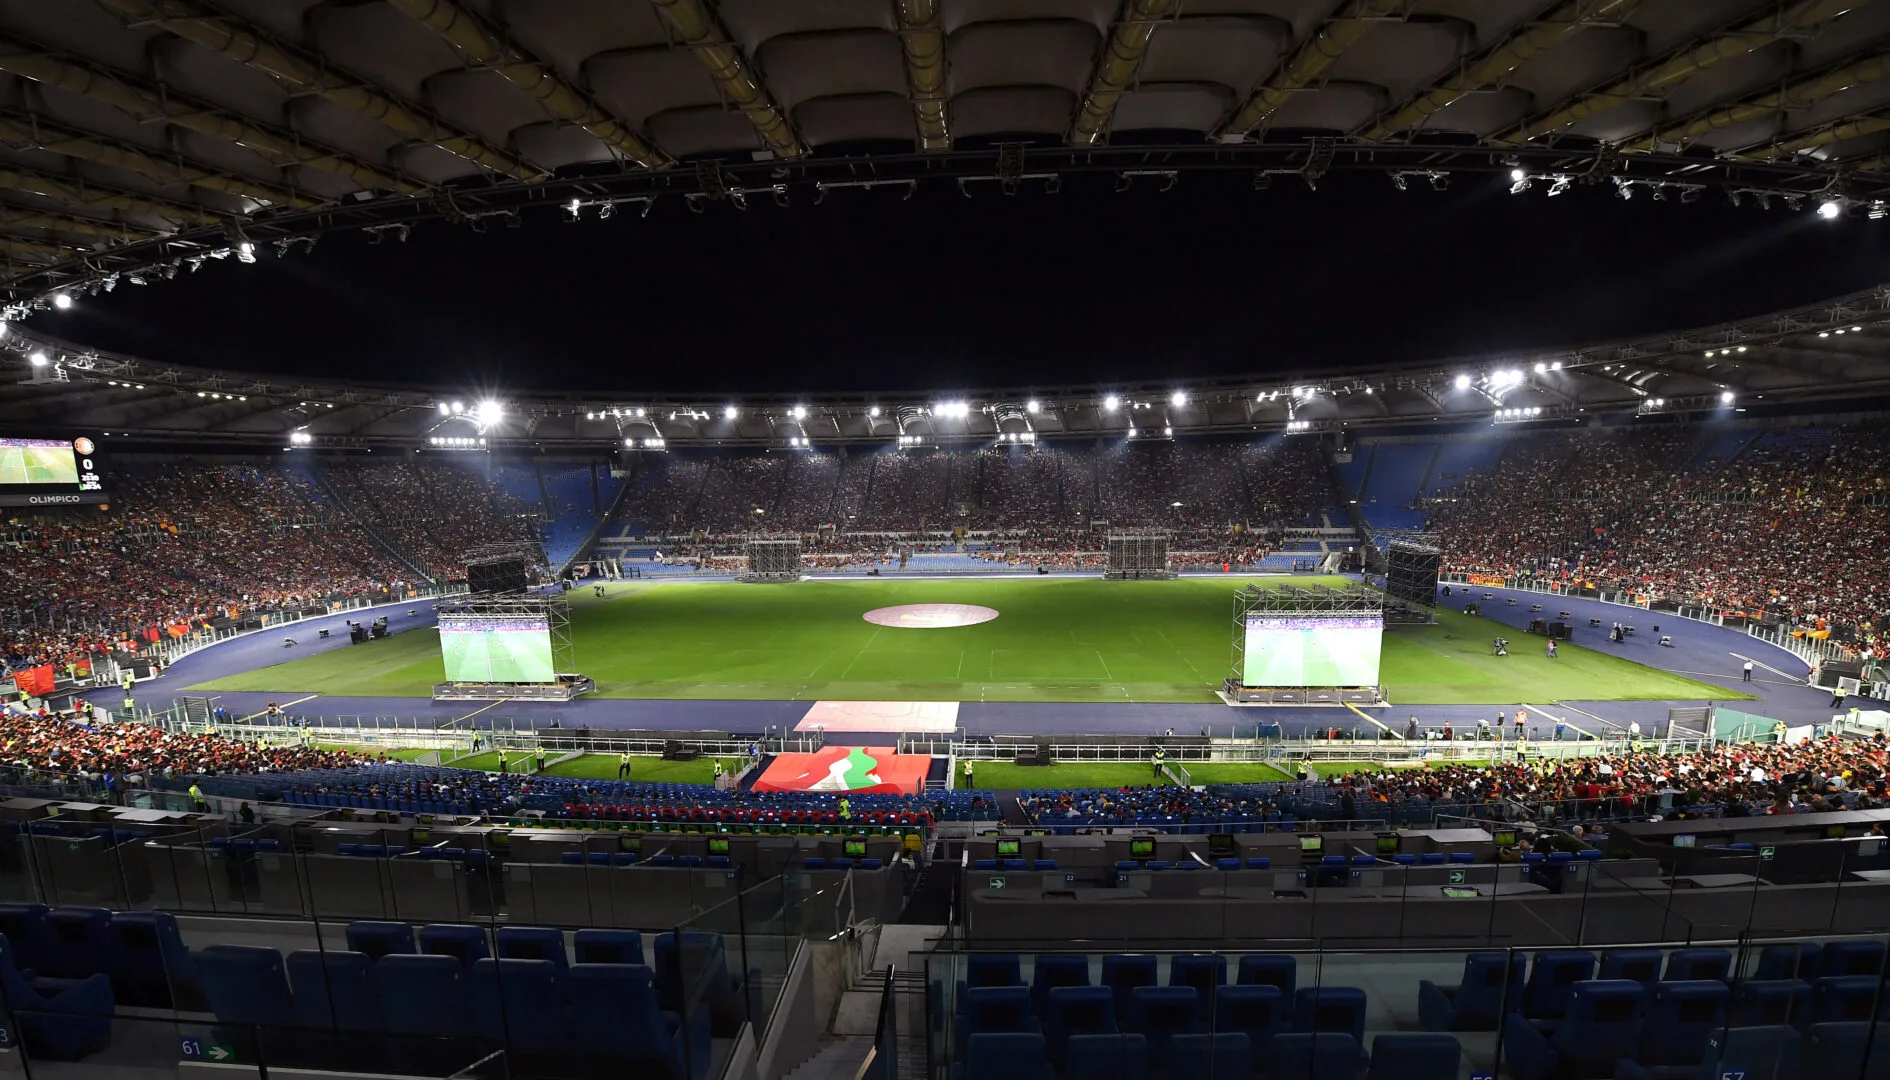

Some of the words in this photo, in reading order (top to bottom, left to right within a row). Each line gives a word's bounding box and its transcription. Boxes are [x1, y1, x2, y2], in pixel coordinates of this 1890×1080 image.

[82, 458, 94, 470] 0
[29, 495, 80, 504] OLIMPICO
[182, 1041, 201, 1055] 61
[1710, 1039, 1719, 1048] 12
